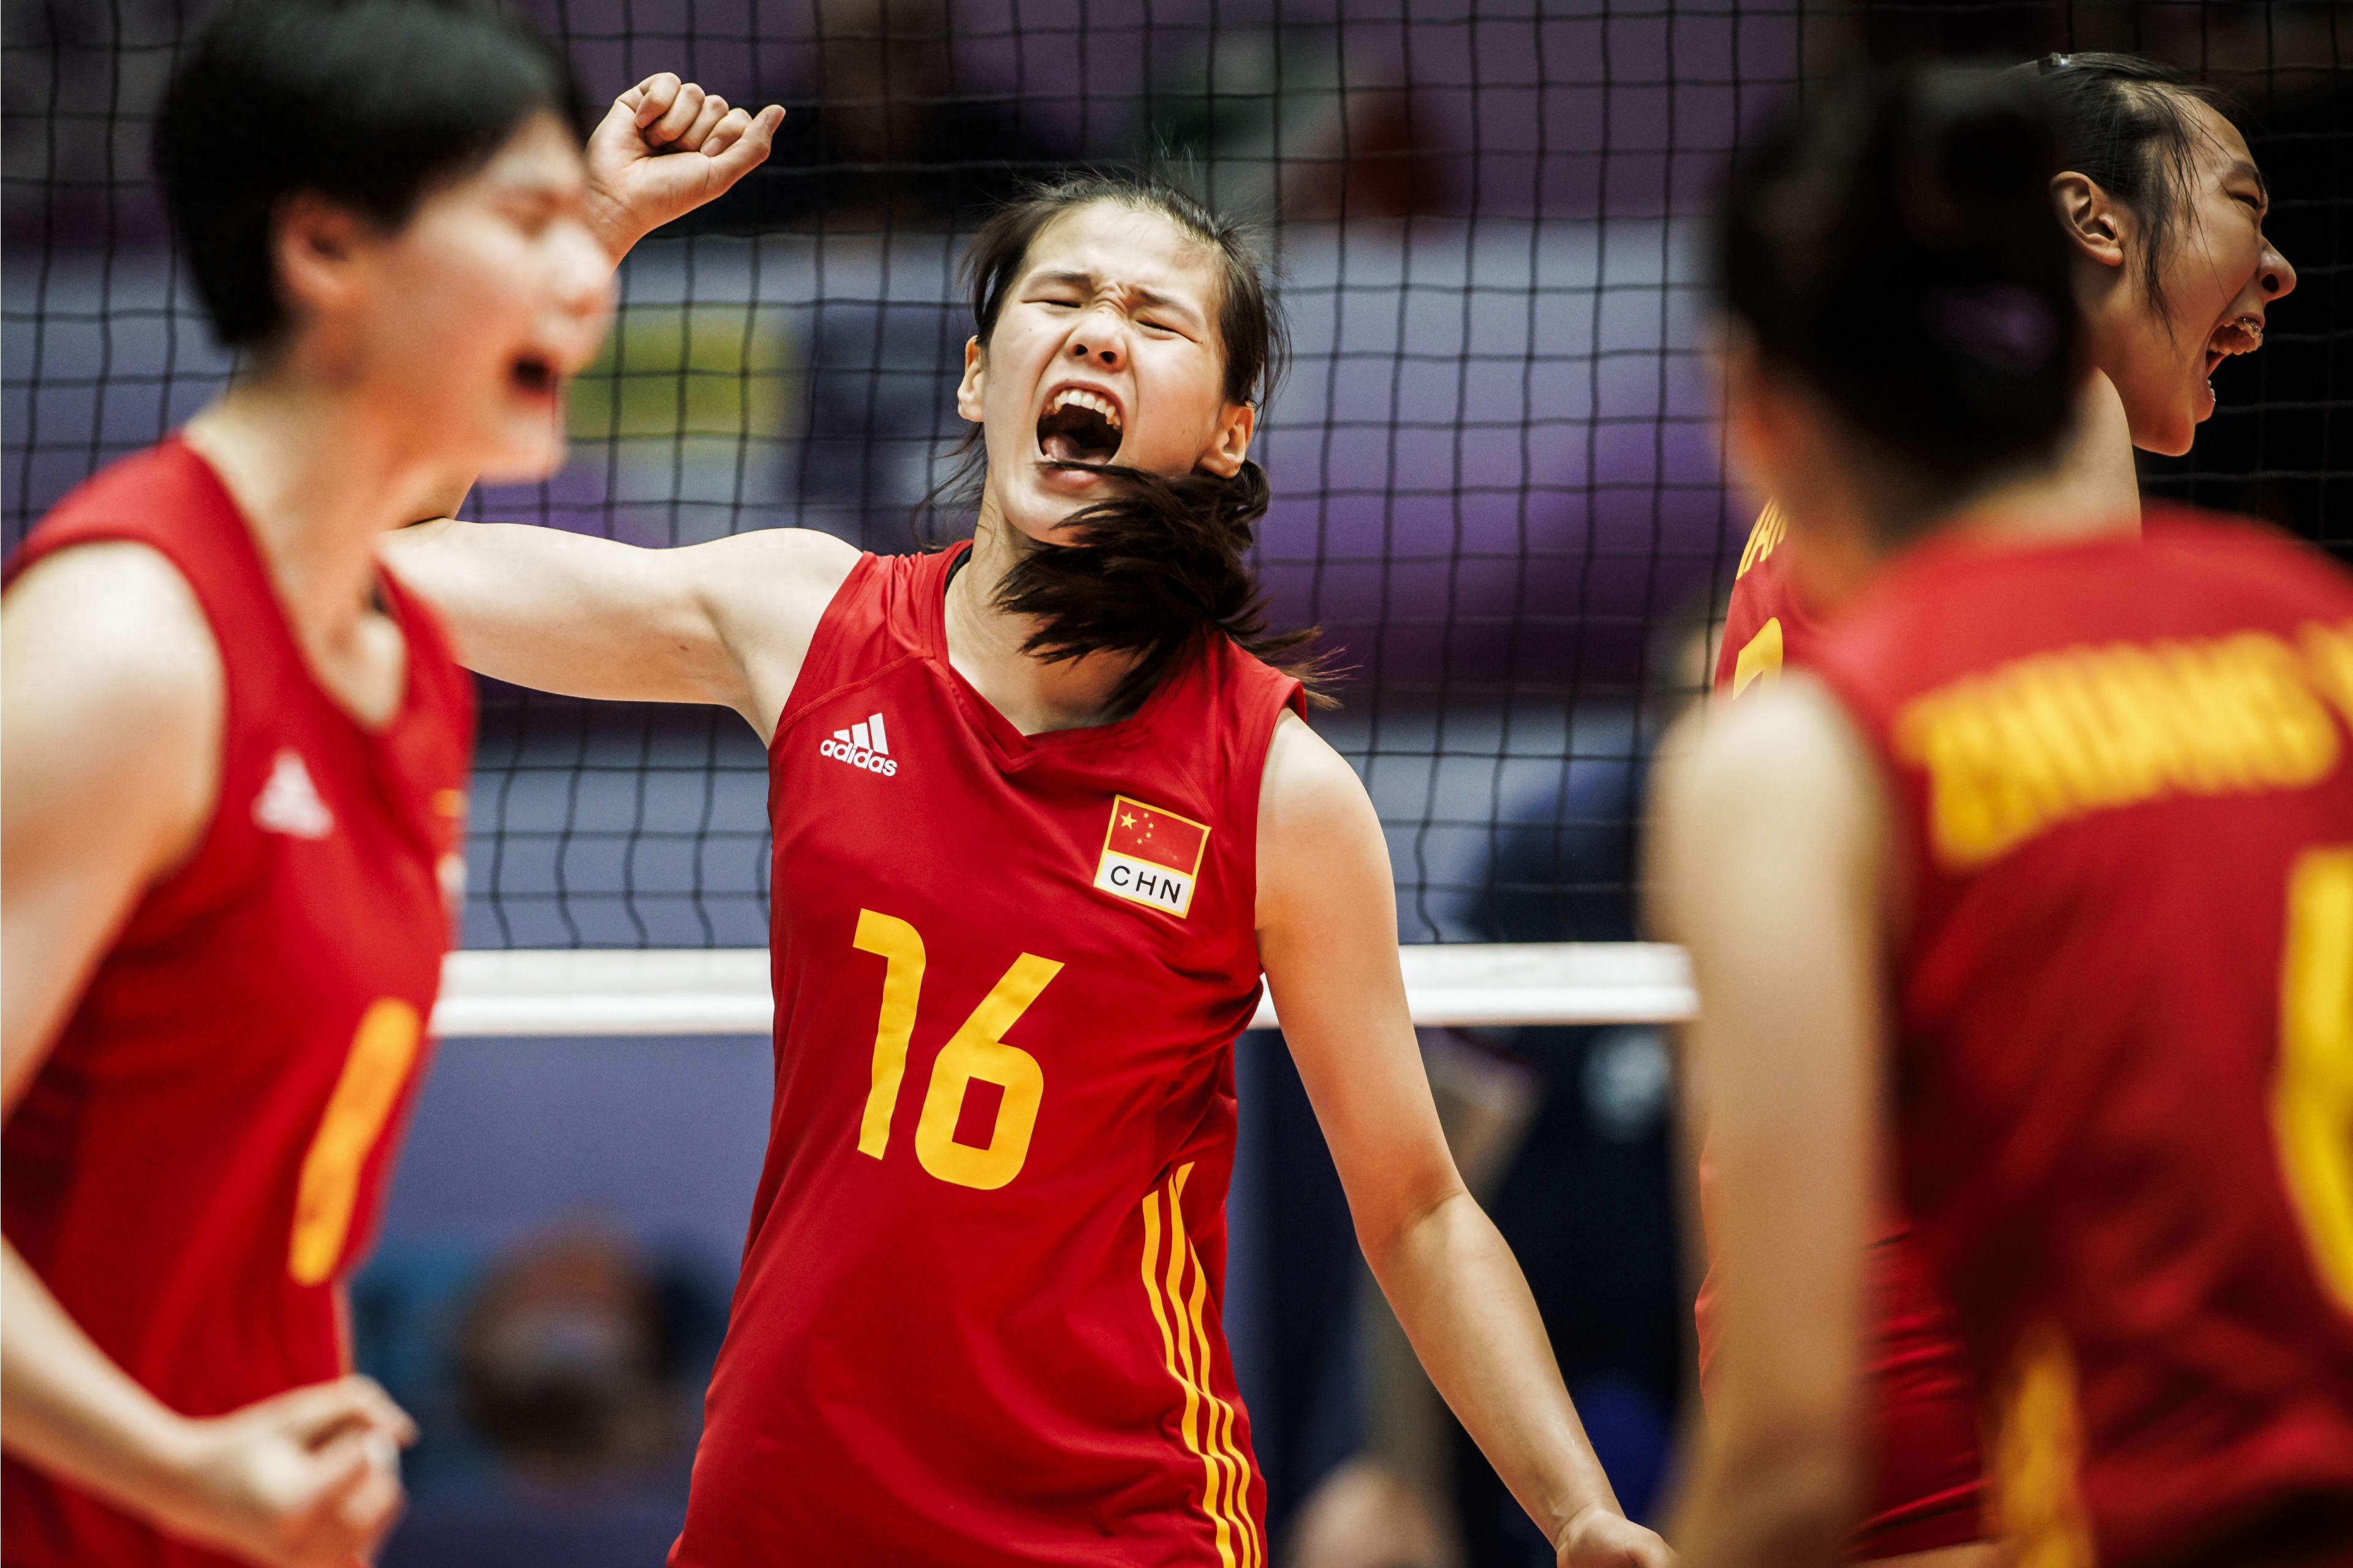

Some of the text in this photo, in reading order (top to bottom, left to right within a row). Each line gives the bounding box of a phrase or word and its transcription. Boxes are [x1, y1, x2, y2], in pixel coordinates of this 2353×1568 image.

[820, 739, 897, 777] adidas
[1110, 865, 1182, 904] CHN
[852, 908, 1065, 1191] 16
